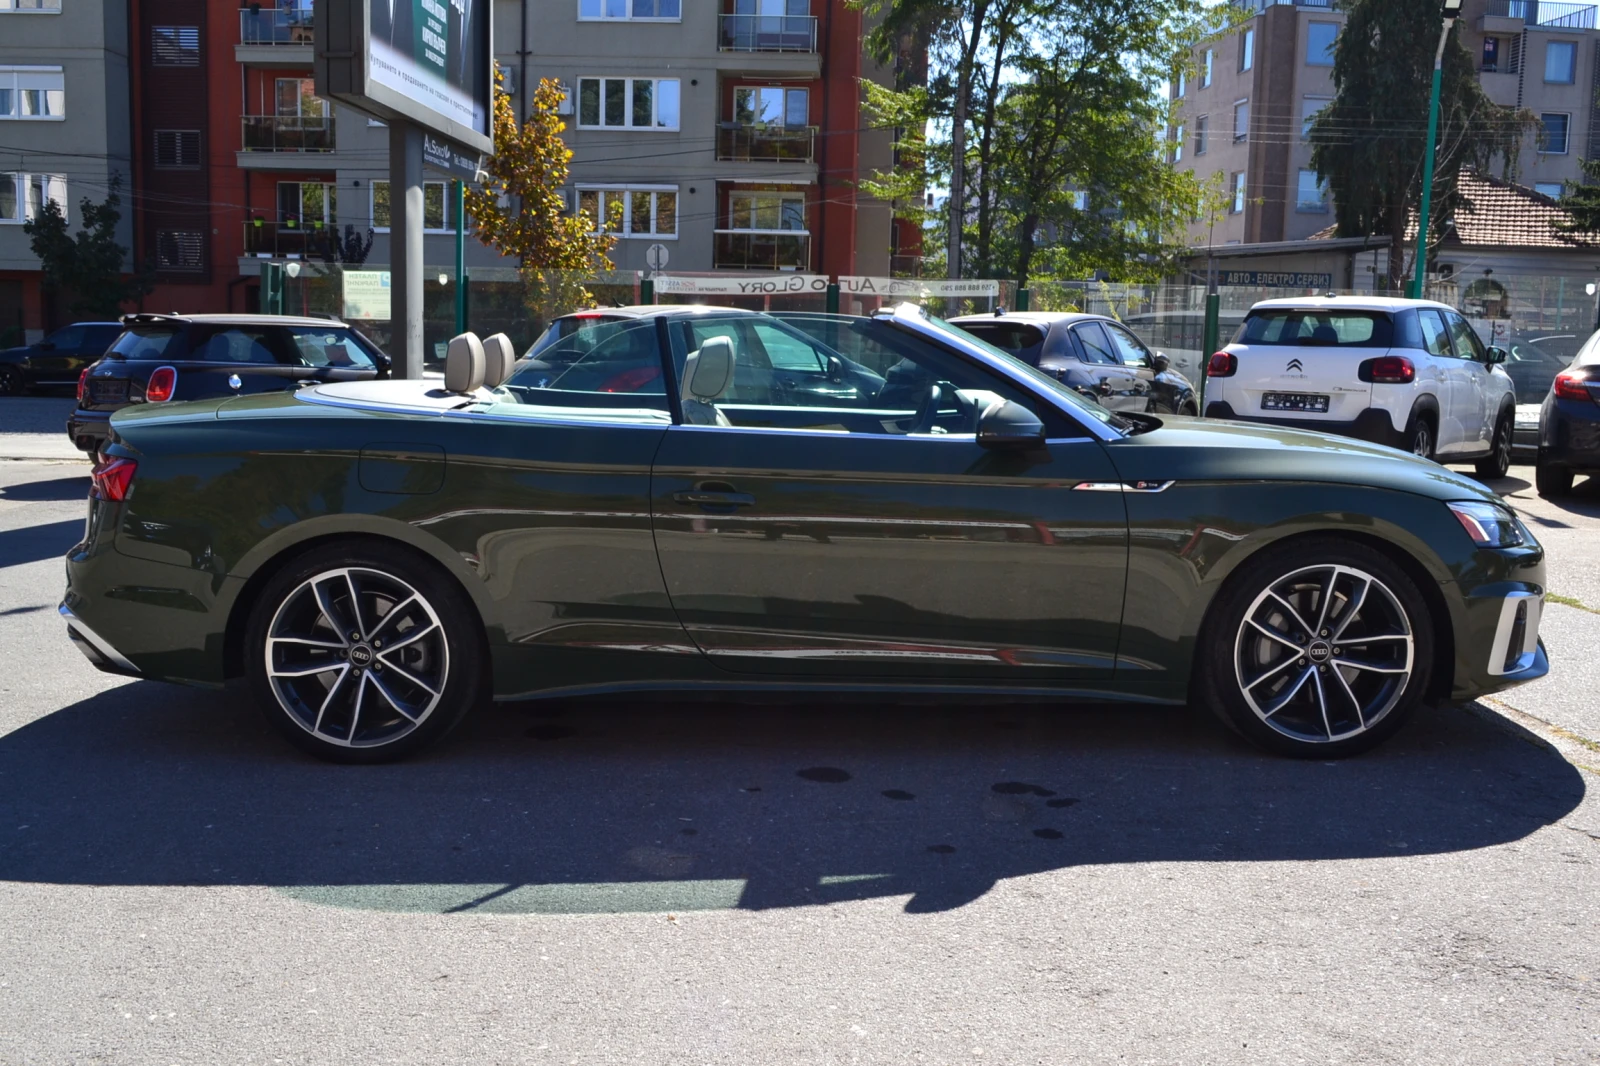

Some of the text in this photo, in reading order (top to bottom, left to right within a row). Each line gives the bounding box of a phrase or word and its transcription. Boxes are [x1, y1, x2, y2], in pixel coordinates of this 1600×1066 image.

[1227, 272, 1250, 283] АВТО
[1256, 273, 1295, 285] ЕЛЕКТРО
[1296, 274, 1330, 286] СЕРВИЗ
